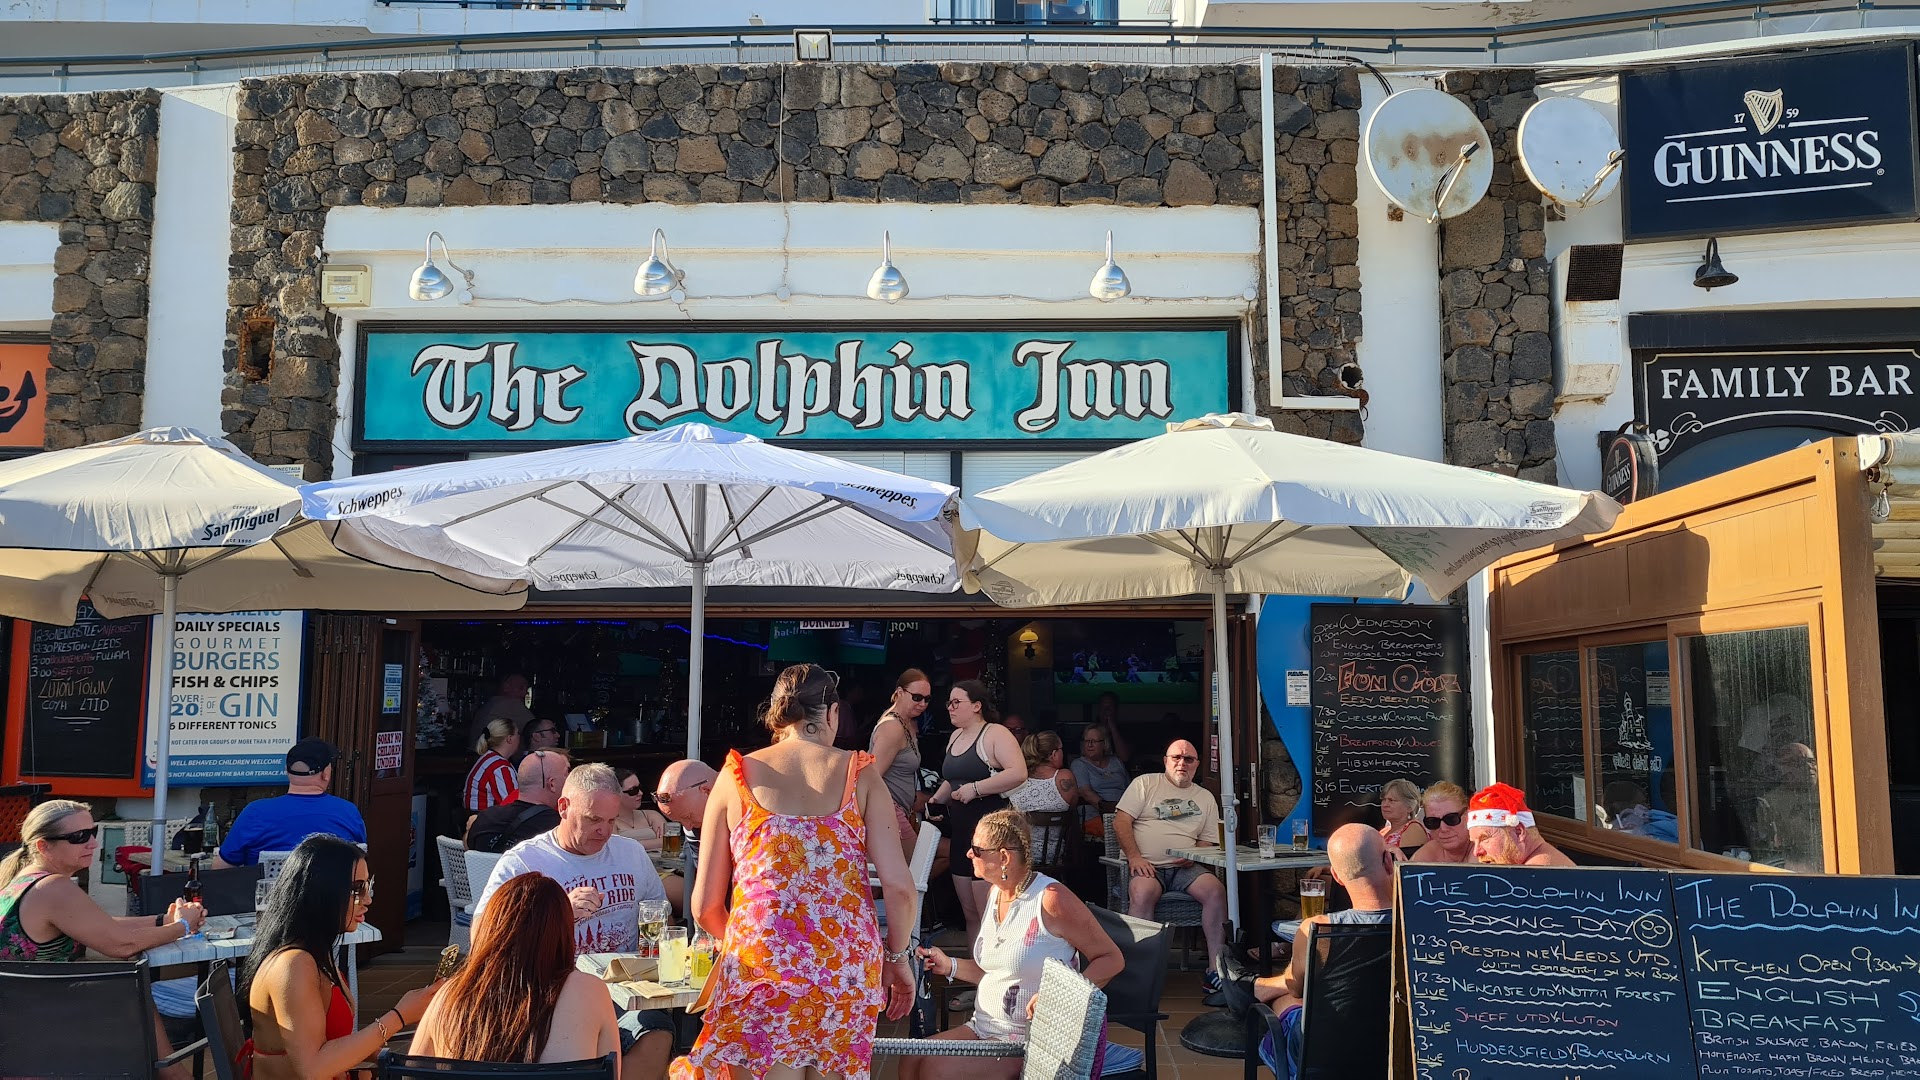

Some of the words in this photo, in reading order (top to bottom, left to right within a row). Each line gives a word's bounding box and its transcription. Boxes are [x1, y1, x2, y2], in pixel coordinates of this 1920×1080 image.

[1733, 112, 1746, 124] 17
[1785, 108, 1800, 119] 59
[1653, 130, 1882, 188] GUINNESS
[411, 342, 588, 431] The
[623, 339, 977, 436] Dolphin
[1012, 339, 1174, 433] Inn
[1661, 366, 1810, 400] FAMILY
[1828, 364, 1914, 397] BAR
[1606, 462, 1631, 495] GUINNESS
[337, 485, 404, 515] Schweppes
[175, 621, 214, 632] DAILY
[218, 621, 280, 632] SPECIALS
[1339, 613, 1433, 630] WEDNESDAY
[91, 638, 122, 651] LEEDS
[174, 637, 281, 649] GOURMET
[1332, 638, 1375, 651] ENGLISH
[1378, 640, 1443, 650] BREAKFASTS
[95, 650, 131, 661] FULHAM
[173, 651, 280, 670] BURGERS
[75, 676, 114, 696] TOWN
[172, 676, 209, 688] FISH
[213, 676, 226, 688] &
[229, 676, 279, 688] CHIPS
[171, 694, 199, 703] OVER
[171, 702, 199, 716] 20
[206, 700, 216, 710] OF
[219, 692, 279, 718] GIN
[1314, 718, 1336, 726] LIVE
[1336, 710, 1384, 722] CHELSEA
[178, 722, 236, 730] DIFFERENT
[238, 720, 277, 730] TONICS
[1338, 734, 1398, 748] BRENTFORD
[1374, 758, 1420, 768] HEARTS
[1338, 778, 1384, 794] EVERT
[611, 873, 636, 888] FUN
[1404, 872, 1469, 898] THE
[1467, 874, 1605, 902] DOLPHIN
[1617, 878, 1663, 902] INN
[606, 888, 636, 906] RIDE
[1676, 878, 1745, 919] THE
[1750, 882, 1878, 920] DOLPHIN
[1894, 888, 1920, 919] IN
[1434, 908, 1565, 930] BOXING
[1571, 916, 1634, 934] DAY
[1413, 948, 1446, 961] LIVE
[1450, 940, 1521, 958] PRESTON
[1562, 940, 1621, 964] LEEDS
[1692, 934, 1790, 975] KITCHEN
[1798, 954, 1852, 973] OPEN
[1482, 960, 1521, 969] WITH
[1650, 966, 1681, 982] BOX
[1413, 984, 1448, 997] LIVE
[1614, 986, 1676, 1002] FOREST
[1698, 980, 1880, 1008] ENGLISH
[1416, 1018, 1451, 1032] LIVE
[1454, 1006, 1509, 1023] SHEFF
[1516, 1013, 1550, 1024] UTD
[1562, 1012, 1619, 1028] LUTON
[1694, 1008, 1886, 1035] BREAKFAST
[1696, 1031, 1750, 1047] BRITISH
[1875, 1040, 1918, 1052] FRIED
[1416, 1050, 1446, 1063] LIVE
[1456, 1038, 1568, 1061] HUDDERSFIELD
[1572, 1042, 1670, 1064] BLACKBURN
[1698, 1050, 1764, 1062] HOMEMADE
[1852, 1055, 1895, 1068] HEINZ
